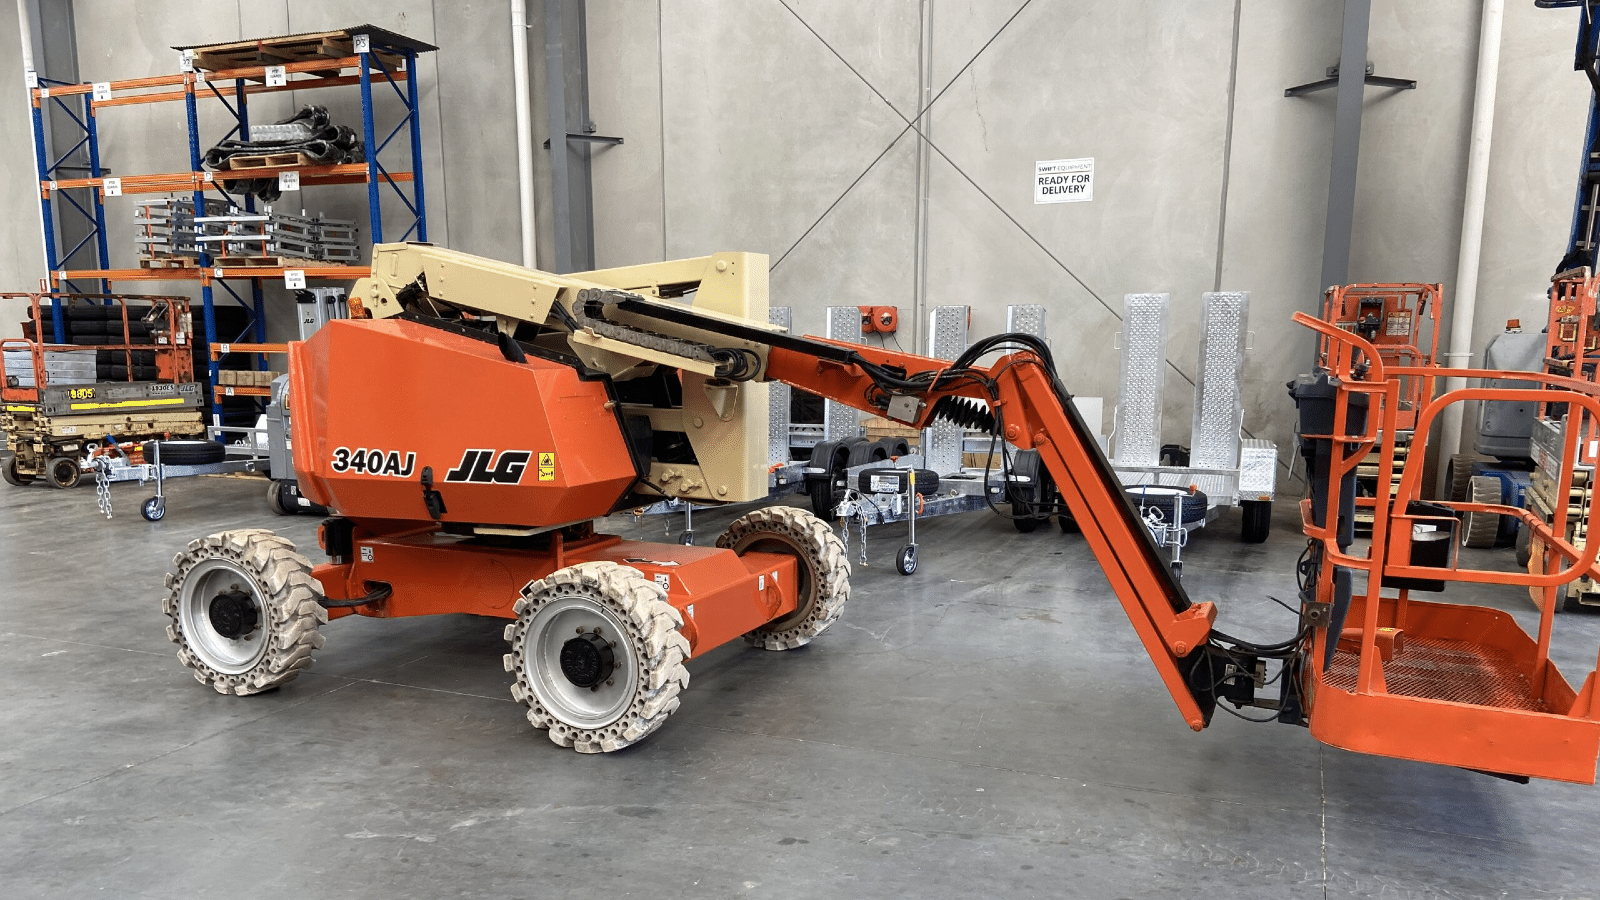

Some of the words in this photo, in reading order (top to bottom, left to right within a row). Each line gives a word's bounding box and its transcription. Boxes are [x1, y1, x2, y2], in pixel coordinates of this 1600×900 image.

[355, 38, 367, 48] P3
[1057, 164, 1091, 172] EQUIPMENT
[1038, 175, 1069, 185] READY
[1071, 174, 1090, 183] FOR
[1042, 184, 1086, 194] DELIVERY
[215, 268, 222, 276] C
[331, 446, 417, 478] 340AJ
[444, 448, 533, 484] JLG
